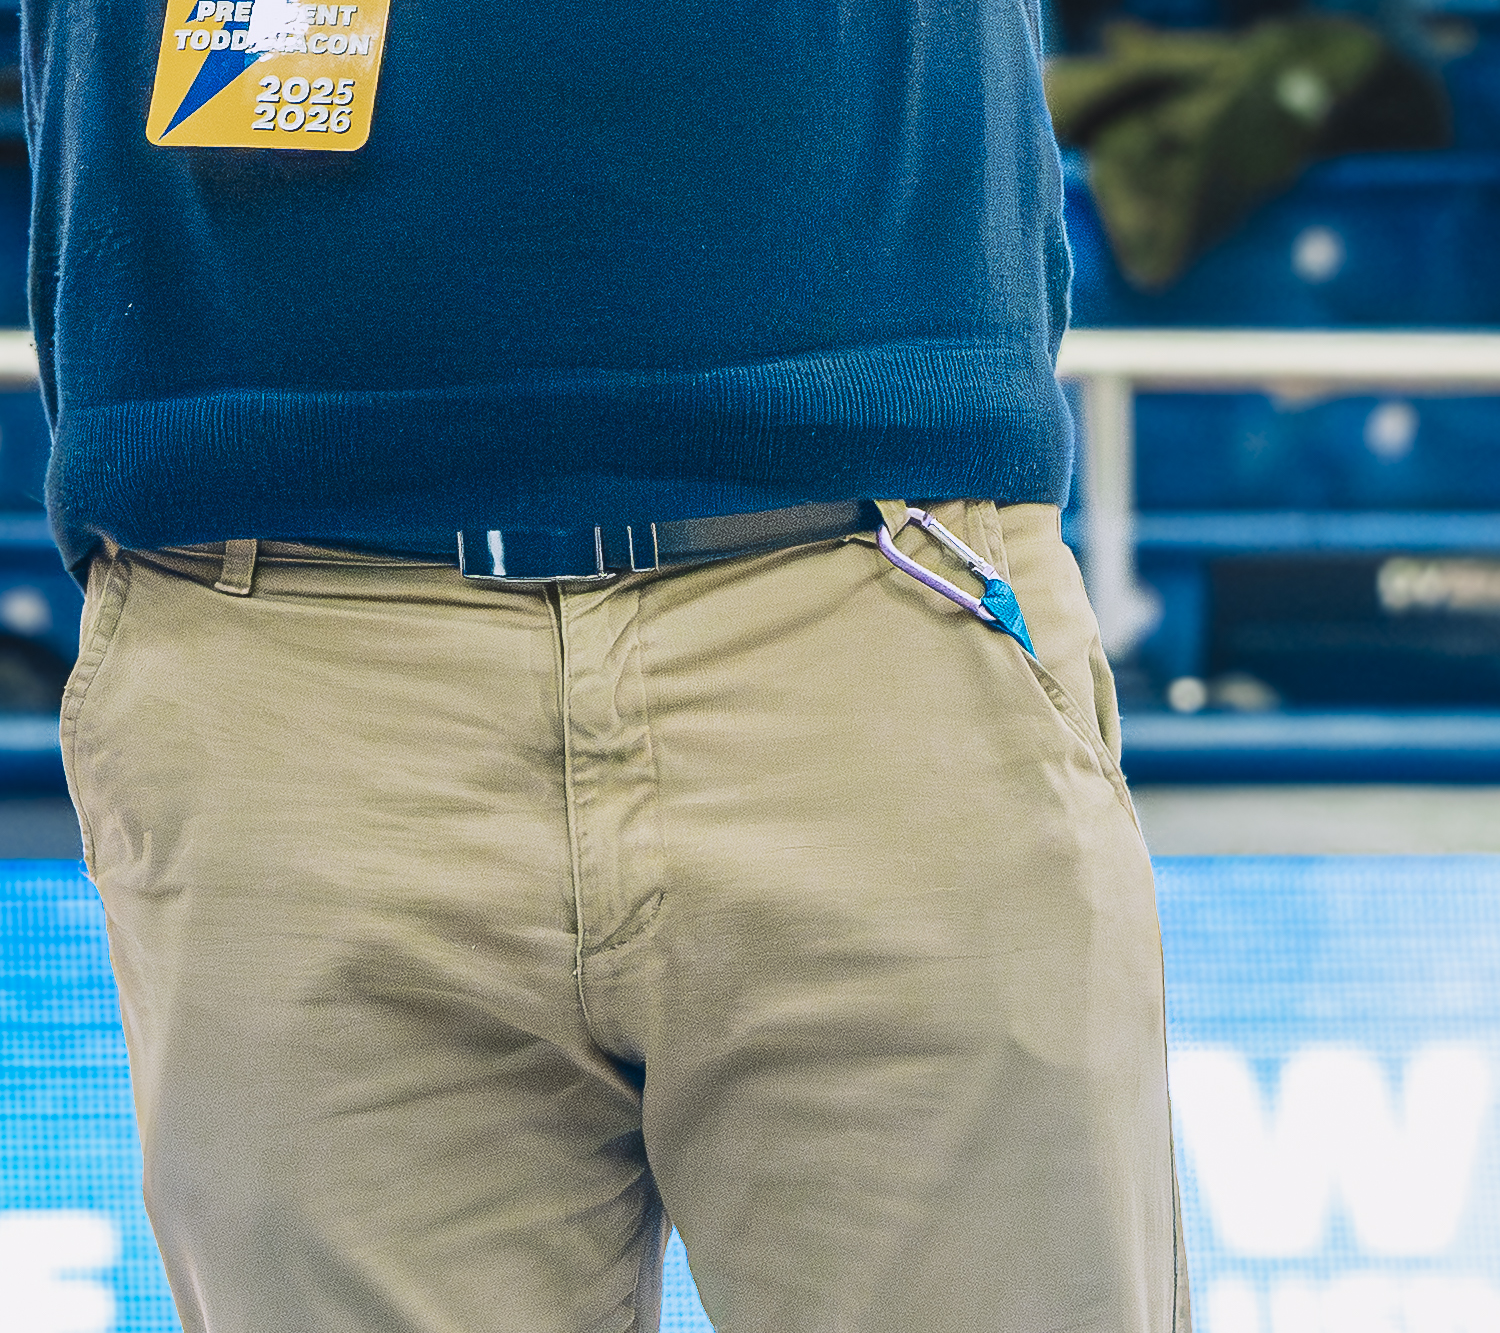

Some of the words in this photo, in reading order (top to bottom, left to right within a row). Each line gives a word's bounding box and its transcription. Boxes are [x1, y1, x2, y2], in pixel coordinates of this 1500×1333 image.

[196, 1, 359, 26] PREENT
[262, 32, 372, 55] ACON
[255, 75, 355, 105] 2025
[251, 106, 354, 133] 2026
